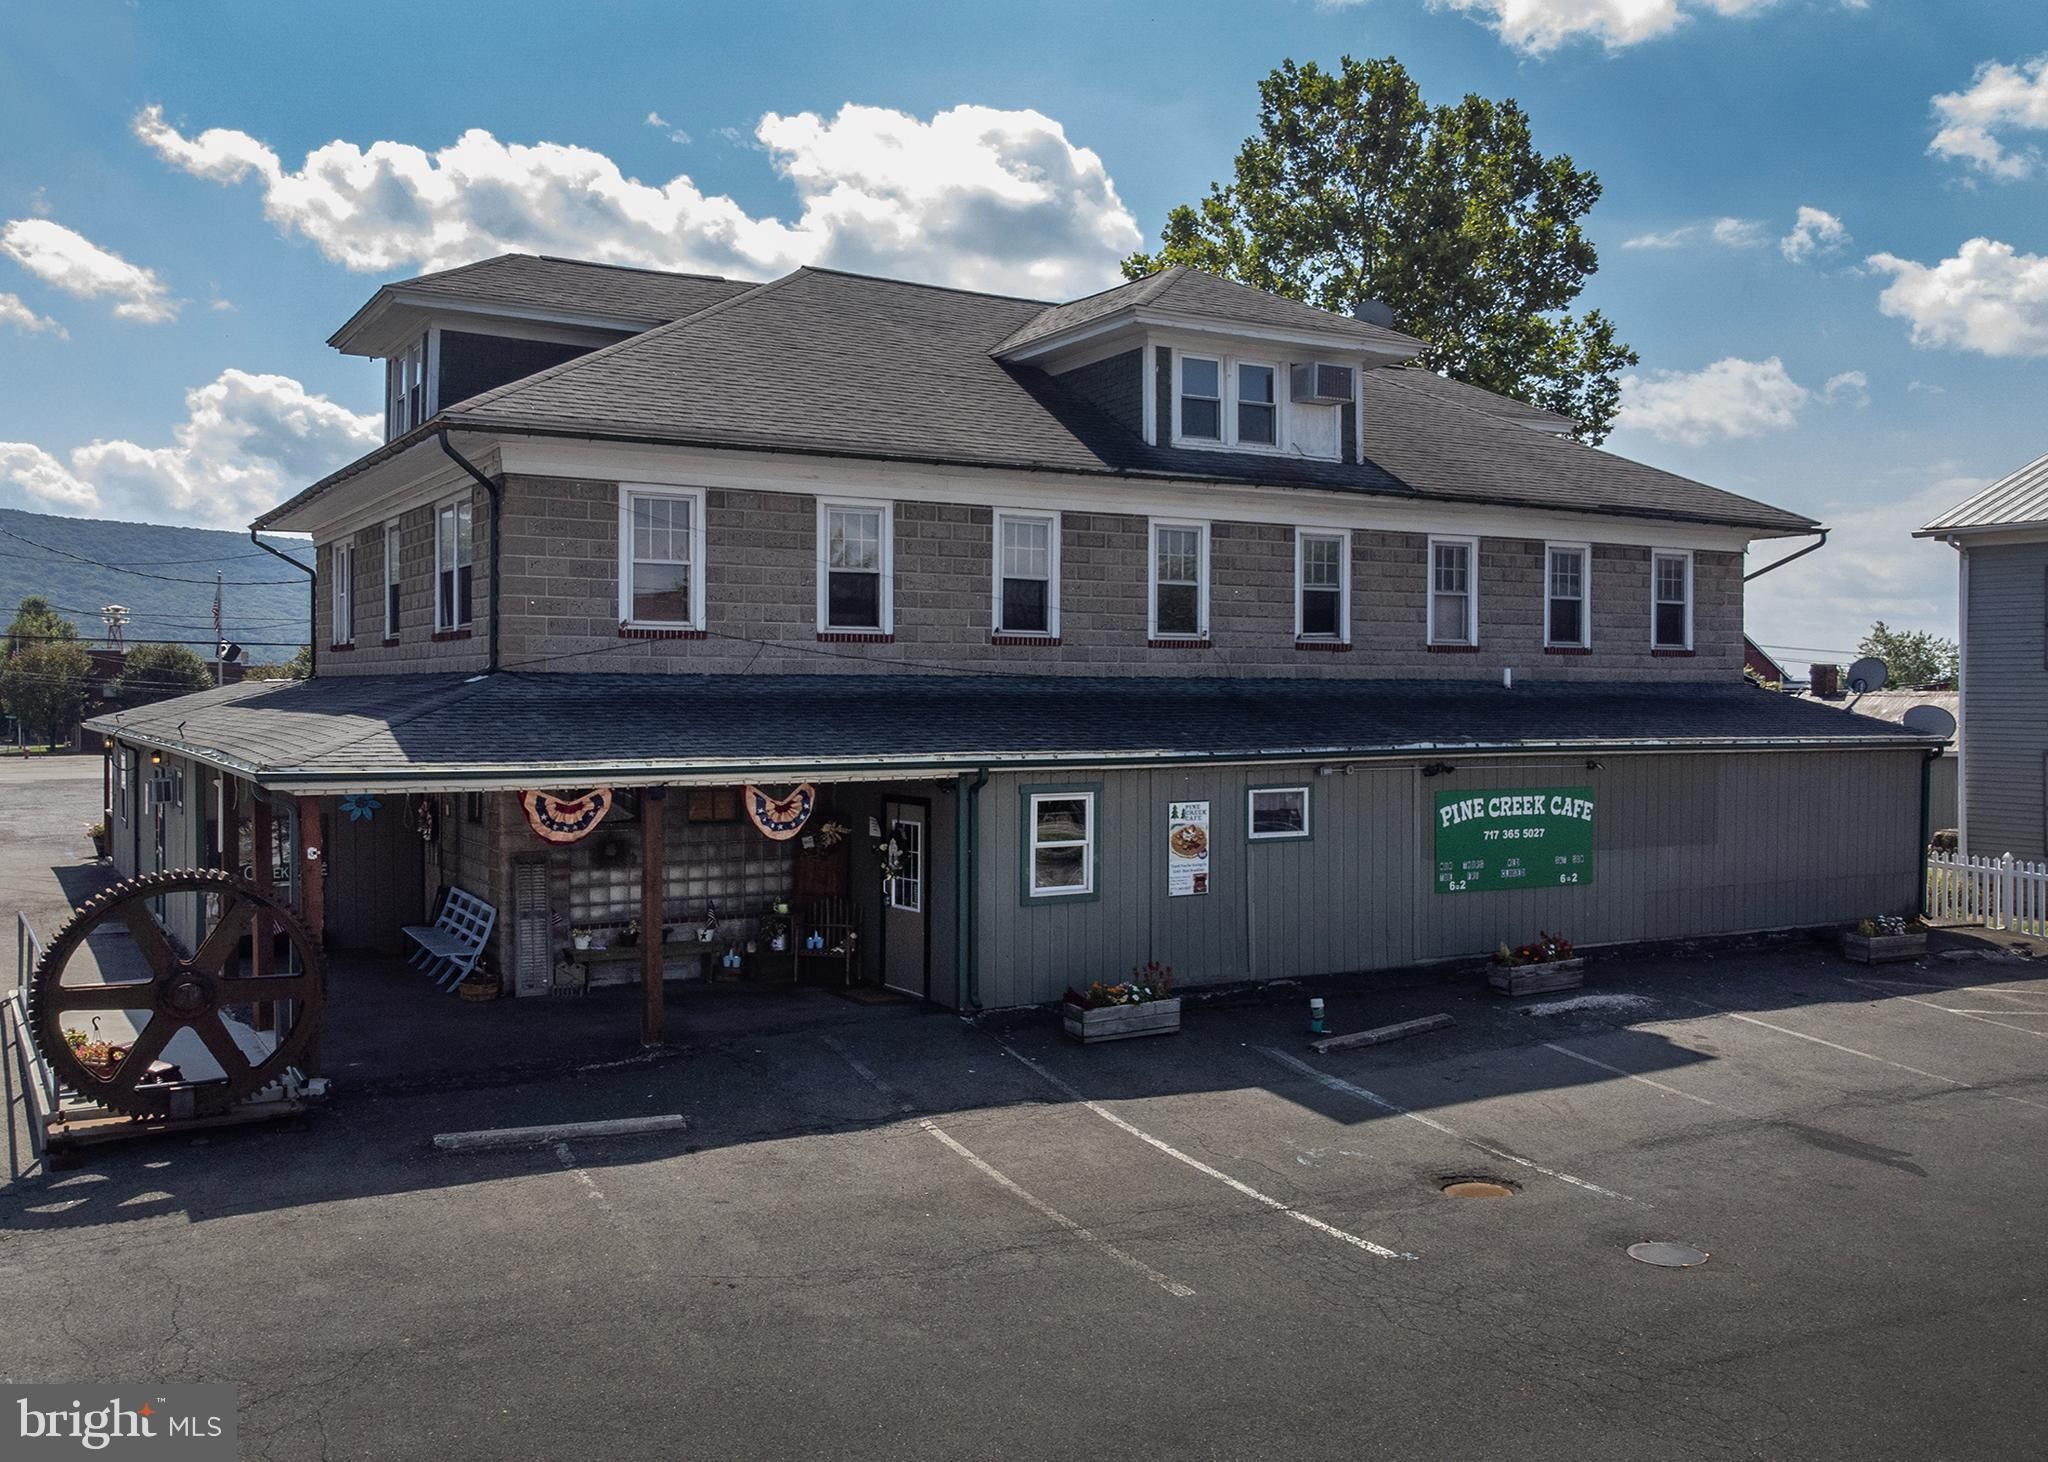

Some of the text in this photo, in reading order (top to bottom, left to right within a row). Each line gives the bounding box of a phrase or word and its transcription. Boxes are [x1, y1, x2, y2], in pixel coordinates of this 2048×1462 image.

[1439, 795, 1594, 828] PINE CREEK CAFE
[1483, 828, 1545, 841] 717 365 5027
